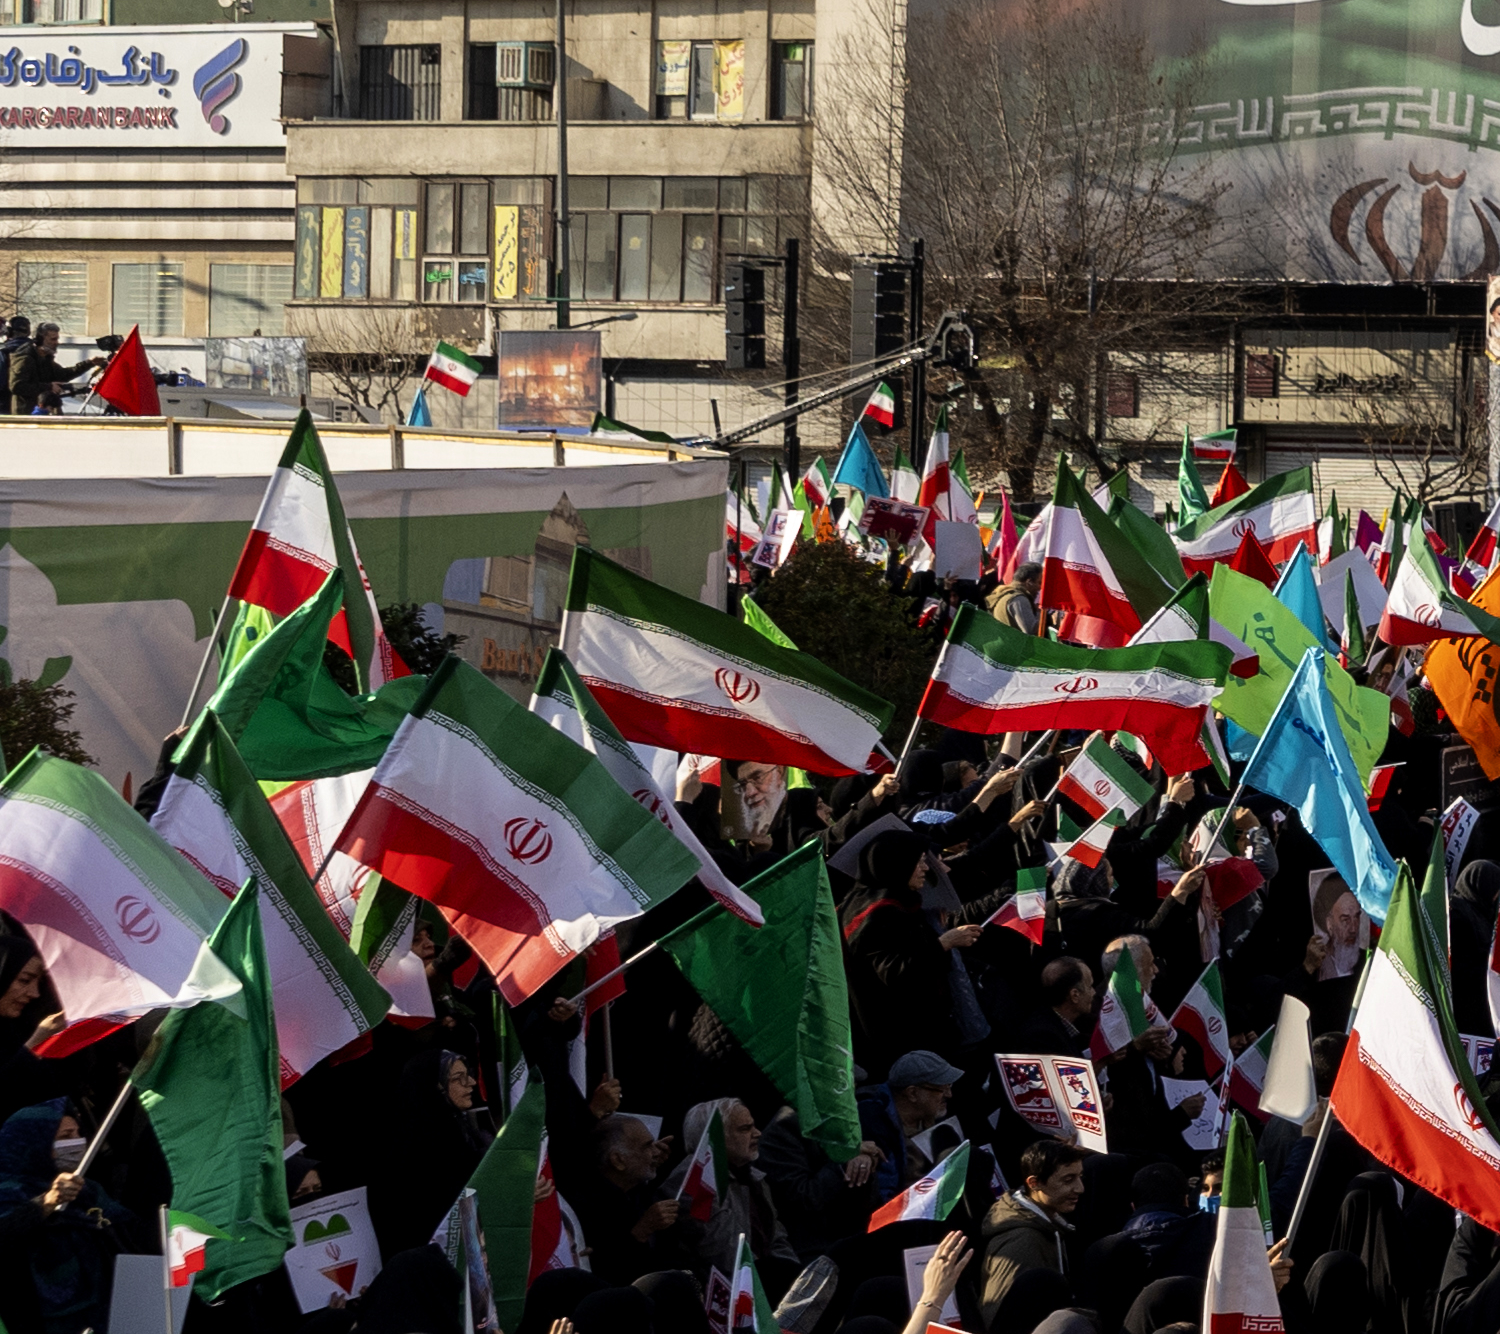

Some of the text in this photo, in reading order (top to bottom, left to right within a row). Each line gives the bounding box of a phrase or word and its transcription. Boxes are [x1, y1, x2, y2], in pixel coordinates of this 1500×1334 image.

[20, 45, 98, 95] رفاه
[96, 45, 178, 98] بانک
[115, 106, 179, 129] BANK
